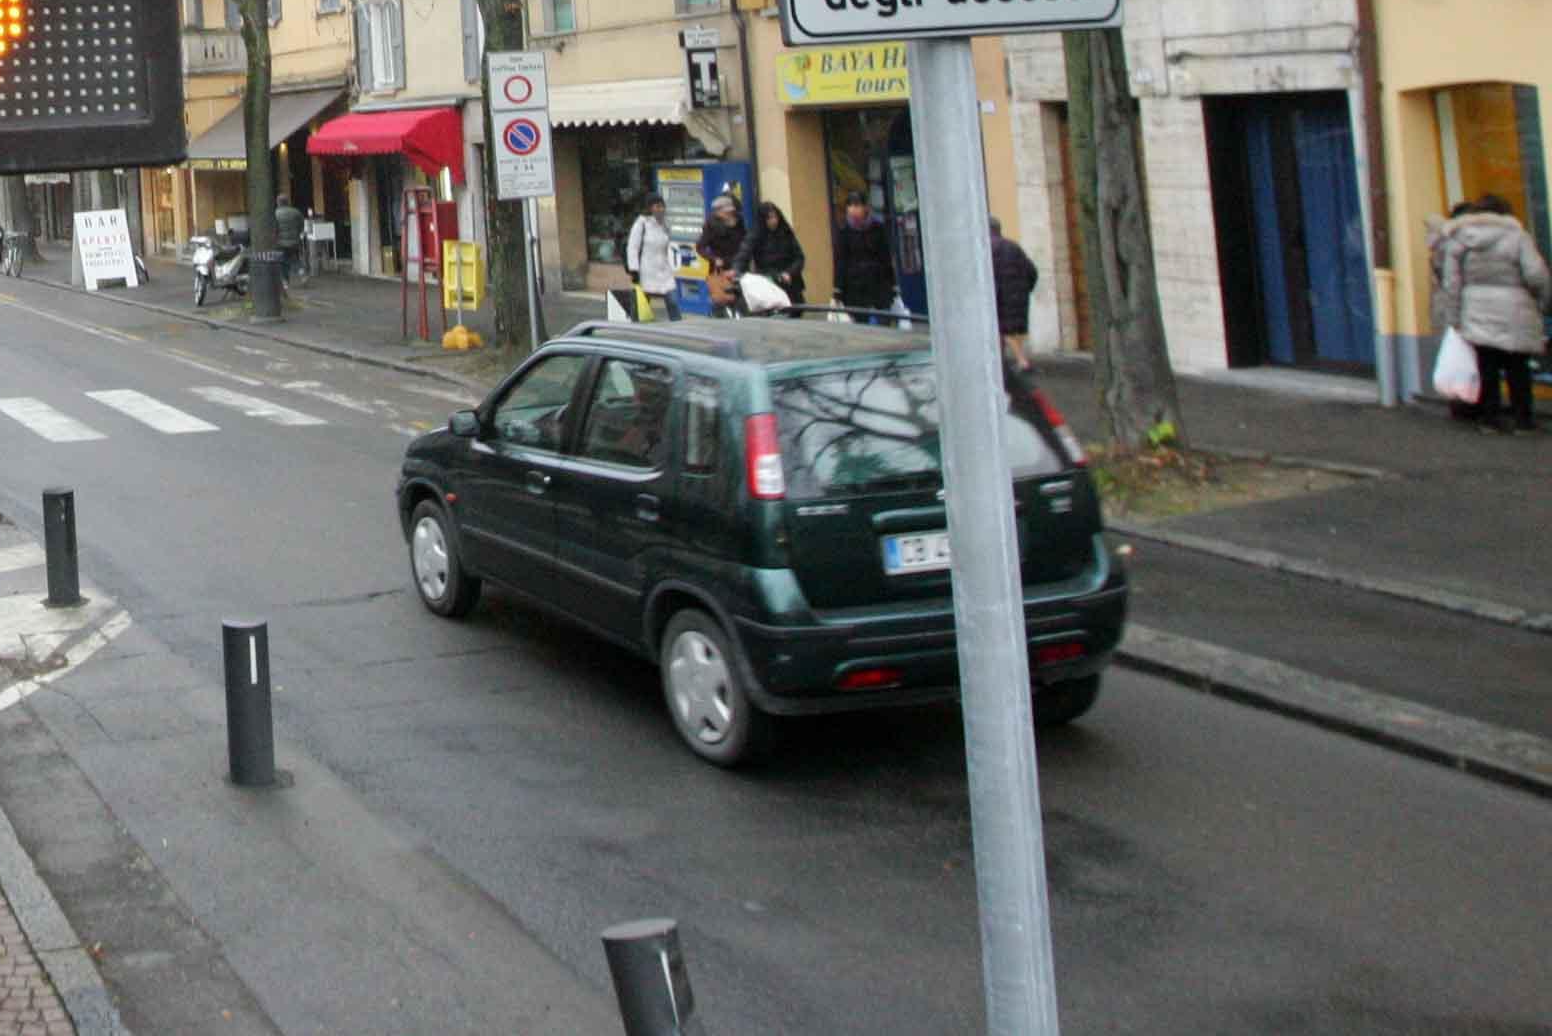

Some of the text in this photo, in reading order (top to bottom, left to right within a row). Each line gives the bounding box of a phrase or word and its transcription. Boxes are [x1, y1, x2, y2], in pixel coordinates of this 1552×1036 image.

[821, 50, 875, 75] BAYA
[856, 76, 906, 95] tours
[83, 214, 118, 229] BAR
